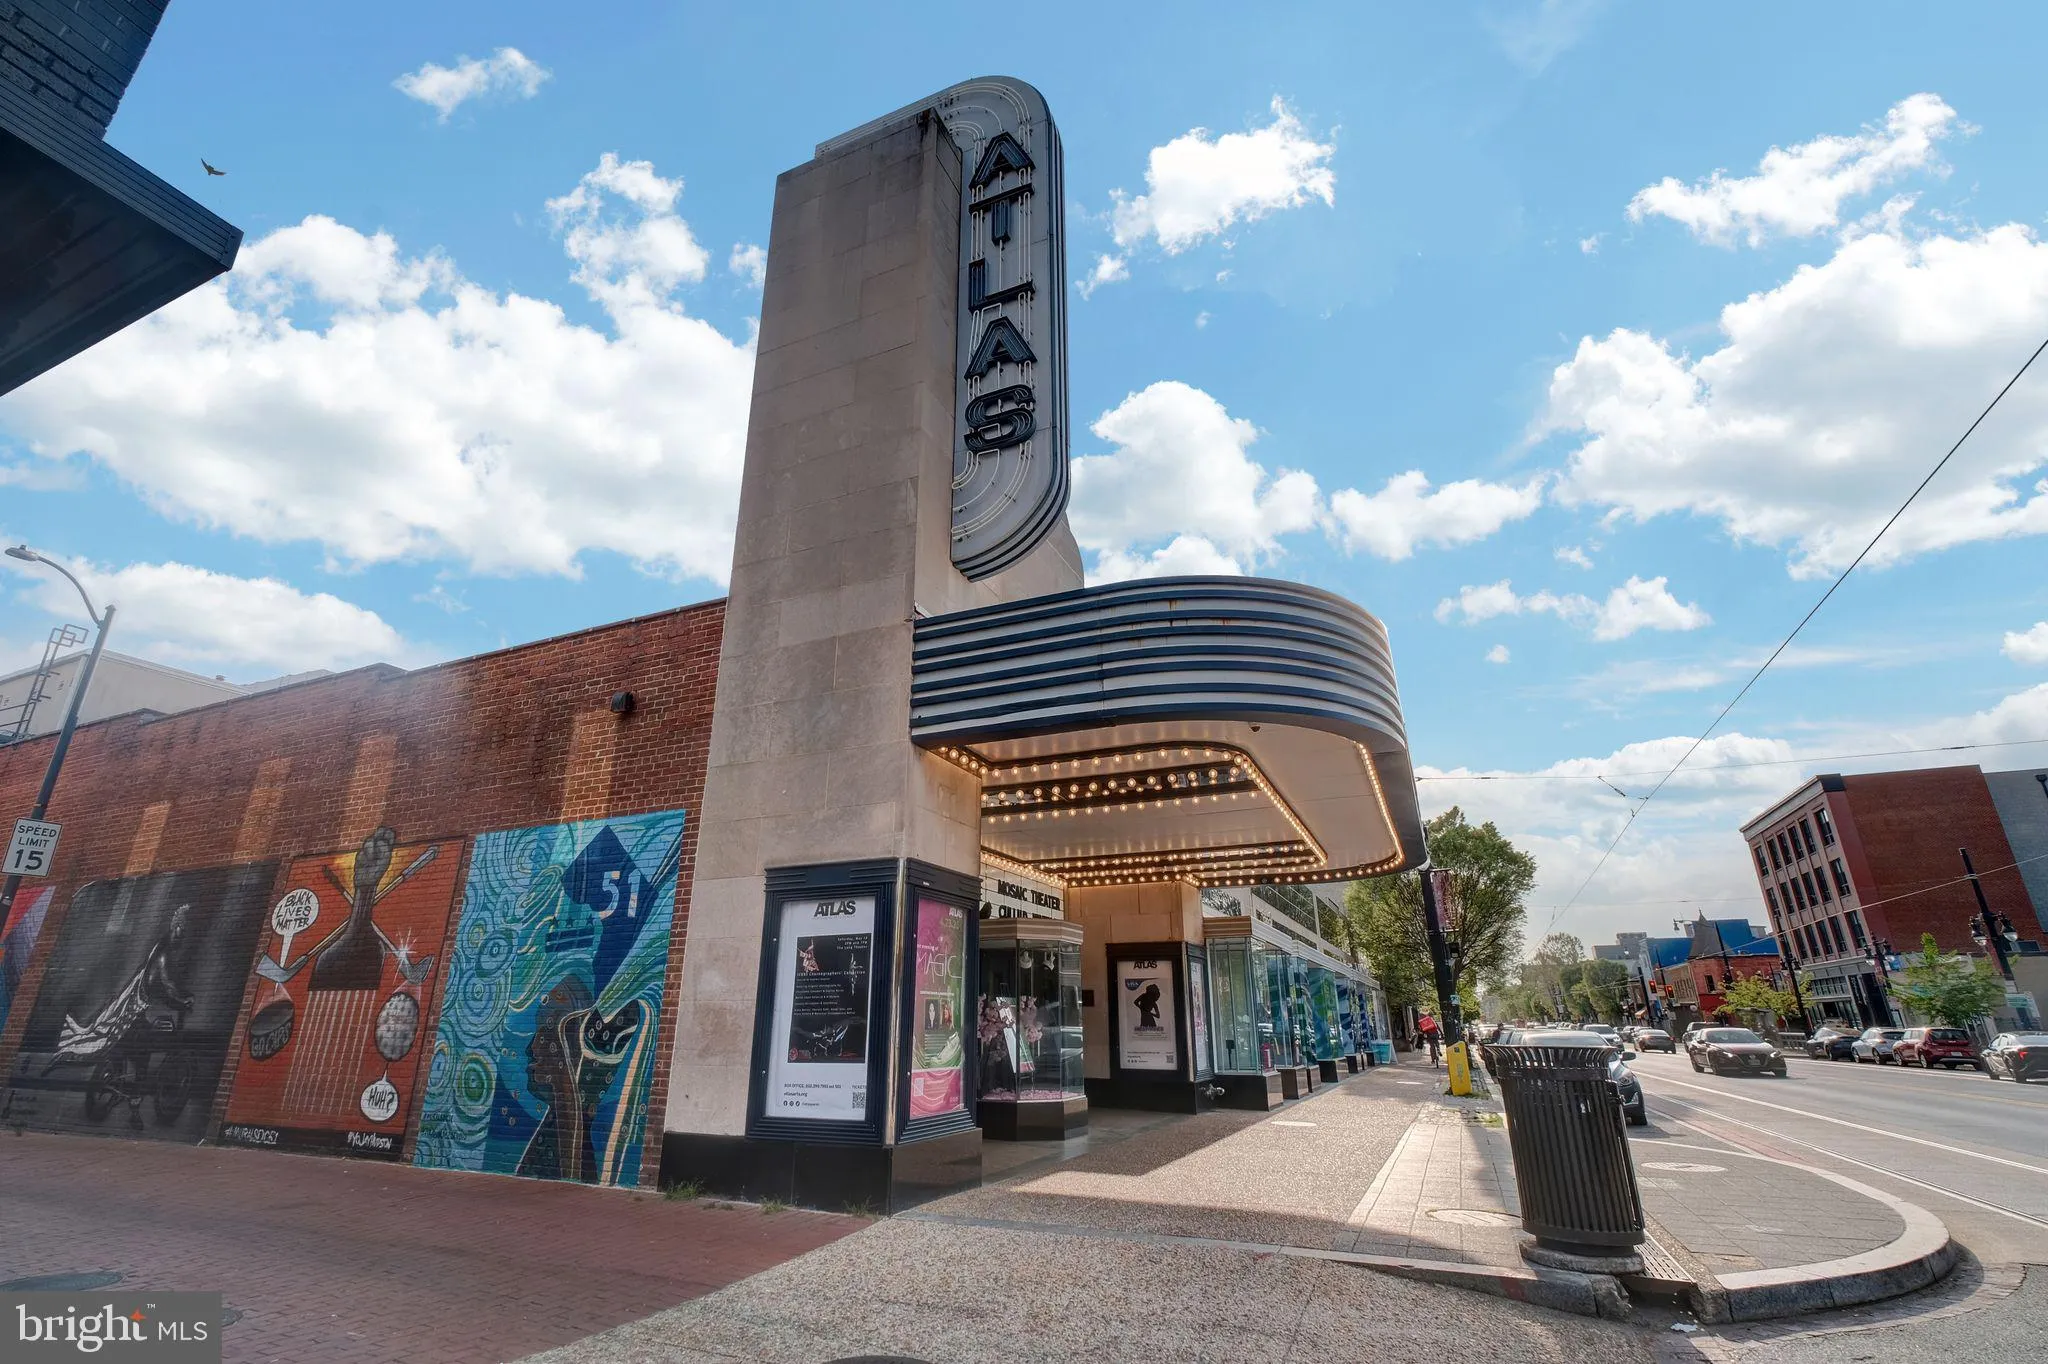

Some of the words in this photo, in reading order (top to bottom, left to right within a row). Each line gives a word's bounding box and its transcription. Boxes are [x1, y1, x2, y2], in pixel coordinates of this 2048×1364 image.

[964, 131, 1037, 450] ATLAS
[18, 825, 57, 837] SPEED
[18, 837, 49, 848] LIMIT
[14, 849, 44, 870] 15
[285, 891, 312, 907] BLACK
[599, 868, 641, 920] 51
[998, 879, 1027, 901] MOSAIC
[1030, 890, 1060, 911] THEATER
[276, 905, 311, 922] LIVES
[814, 900, 856, 917] ATLAS
[275, 918, 309, 930] MATTER
[1133, 960, 1157, 969] ATLAS
[368, 1086, 396, 1112] HUH?
